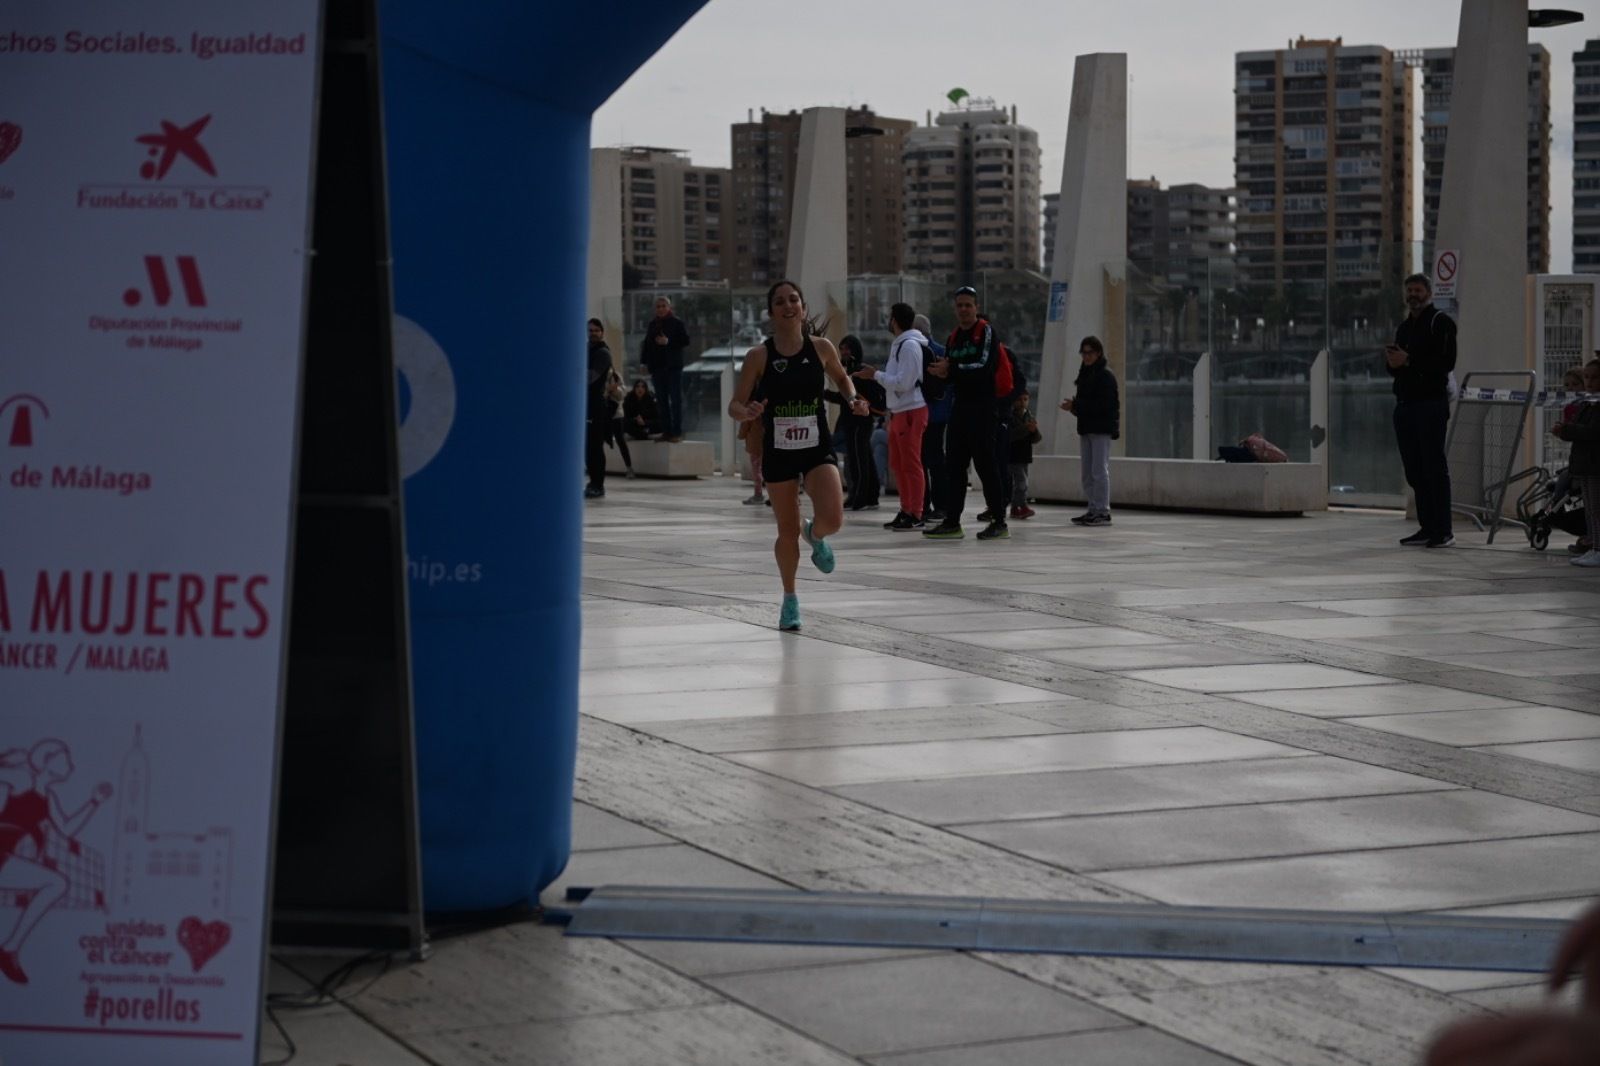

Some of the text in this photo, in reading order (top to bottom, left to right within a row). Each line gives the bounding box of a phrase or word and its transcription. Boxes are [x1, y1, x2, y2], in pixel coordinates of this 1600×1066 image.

[64, 31, 182, 54] Sociales.
[191, 33, 306, 59] Igualdad
[77, 189, 178, 209] Fundación
[89, 316, 242, 332] Diputación Provincial
[126, 335, 145, 349] de
[784, 427, 809, 441] 4177
[10, 463, 152, 496] de Málaga
[30, 569, 270, 639] MUJERES
[85, 645, 170, 672] MALAGA
[105, 919, 166, 938] unidos
[79, 934, 137, 950] contra
[88, 950, 105, 964] el
[84, 987, 201, 1026] #porellas
